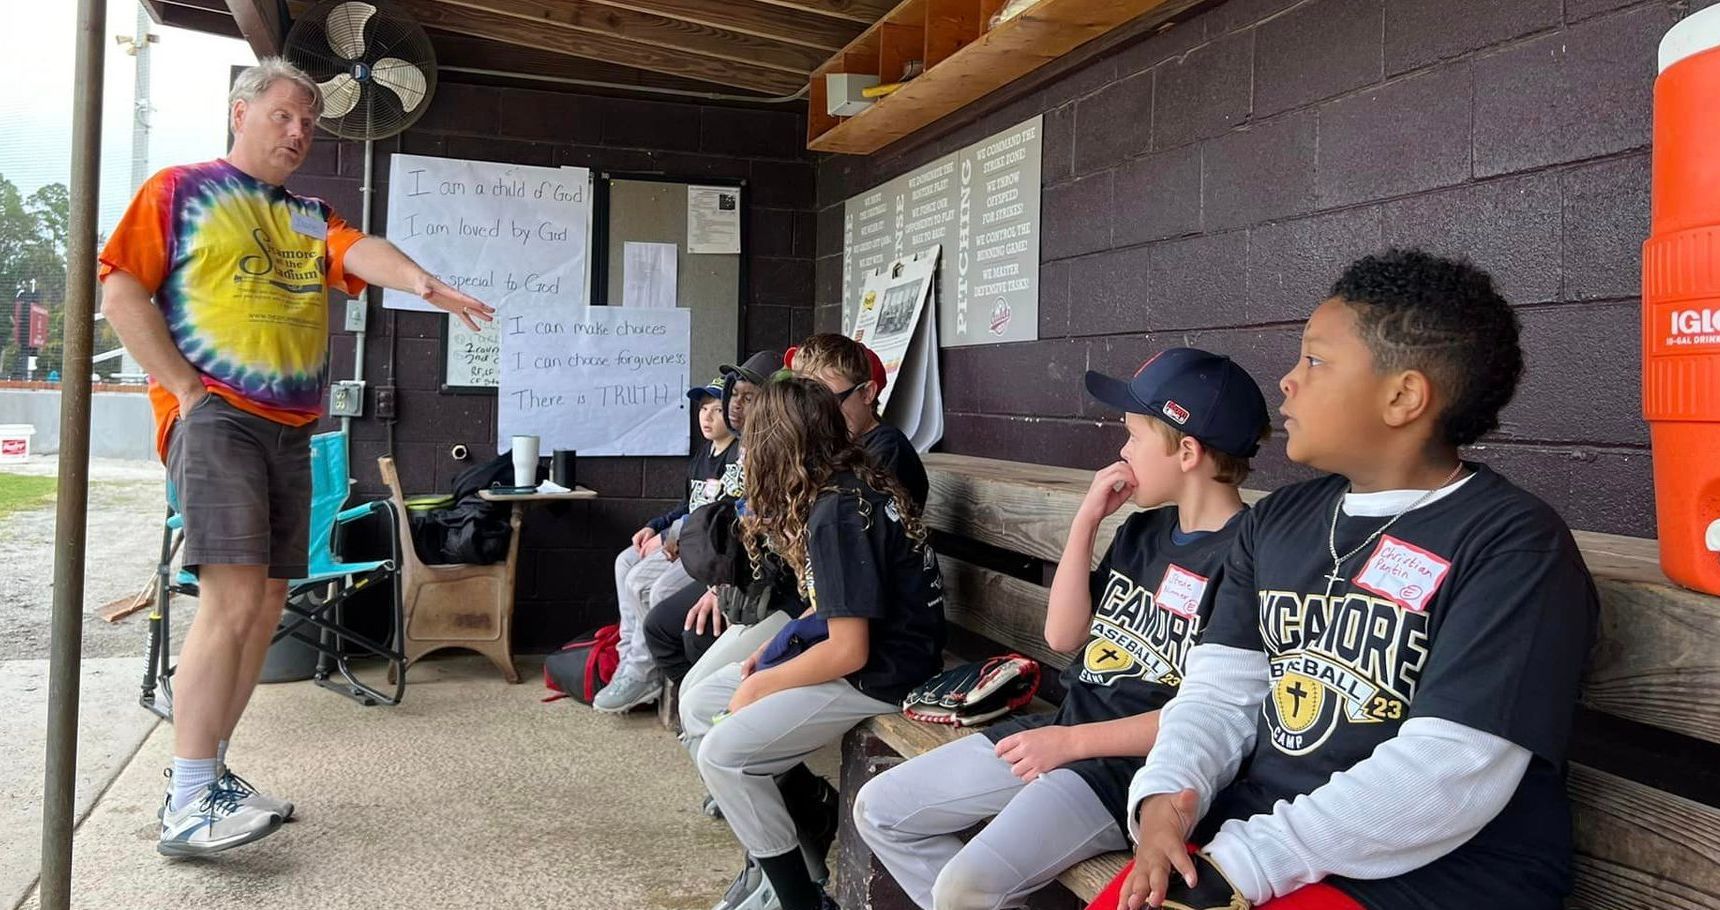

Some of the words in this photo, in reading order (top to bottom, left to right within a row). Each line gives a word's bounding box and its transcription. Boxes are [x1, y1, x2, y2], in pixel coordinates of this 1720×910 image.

[1022, 127, 1036, 142] THE
[408, 169, 431, 197] I
[439, 182, 465, 195] am
[475, 184, 485, 194] a
[492, 178, 526, 199] child
[533, 180, 552, 199] of
[553, 185, 583, 203] God
[402, 213, 421, 241] I
[426, 221, 449, 237] am
[459, 218, 500, 238] loved
[512, 220, 531, 246] by
[538, 222, 568, 242] God
[976, 234, 986, 246] WE
[986, 225, 1016, 244] CONTROL
[1016, 222, 1031, 236] THE
[956, 159, 972, 336] PITCHING
[449, 271, 494, 293] special
[505, 273, 518, 291] to
[524, 273, 560, 294] God
[509, 315, 525, 335] I
[534, 321, 564, 335] can
[573, 322, 609, 336] make
[616, 320, 666, 336] choices
[511, 352, 525, 370] I
[534, 357, 562, 370] can
[568, 353, 610, 367] choose
[616, 349, 686, 371] forgiveness
[511, 388, 565, 410] There
[577, 393, 586, 405] is
[597, 383, 668, 406] TRUTH
[1380, 546, 1433, 579] Christian
[1091, 622, 1161, 675] ASEBALL
[1161, 673, 1181, 687] 23
[1373, 697, 1403, 720] 23
[1273, 727, 1303, 749] CAMP
